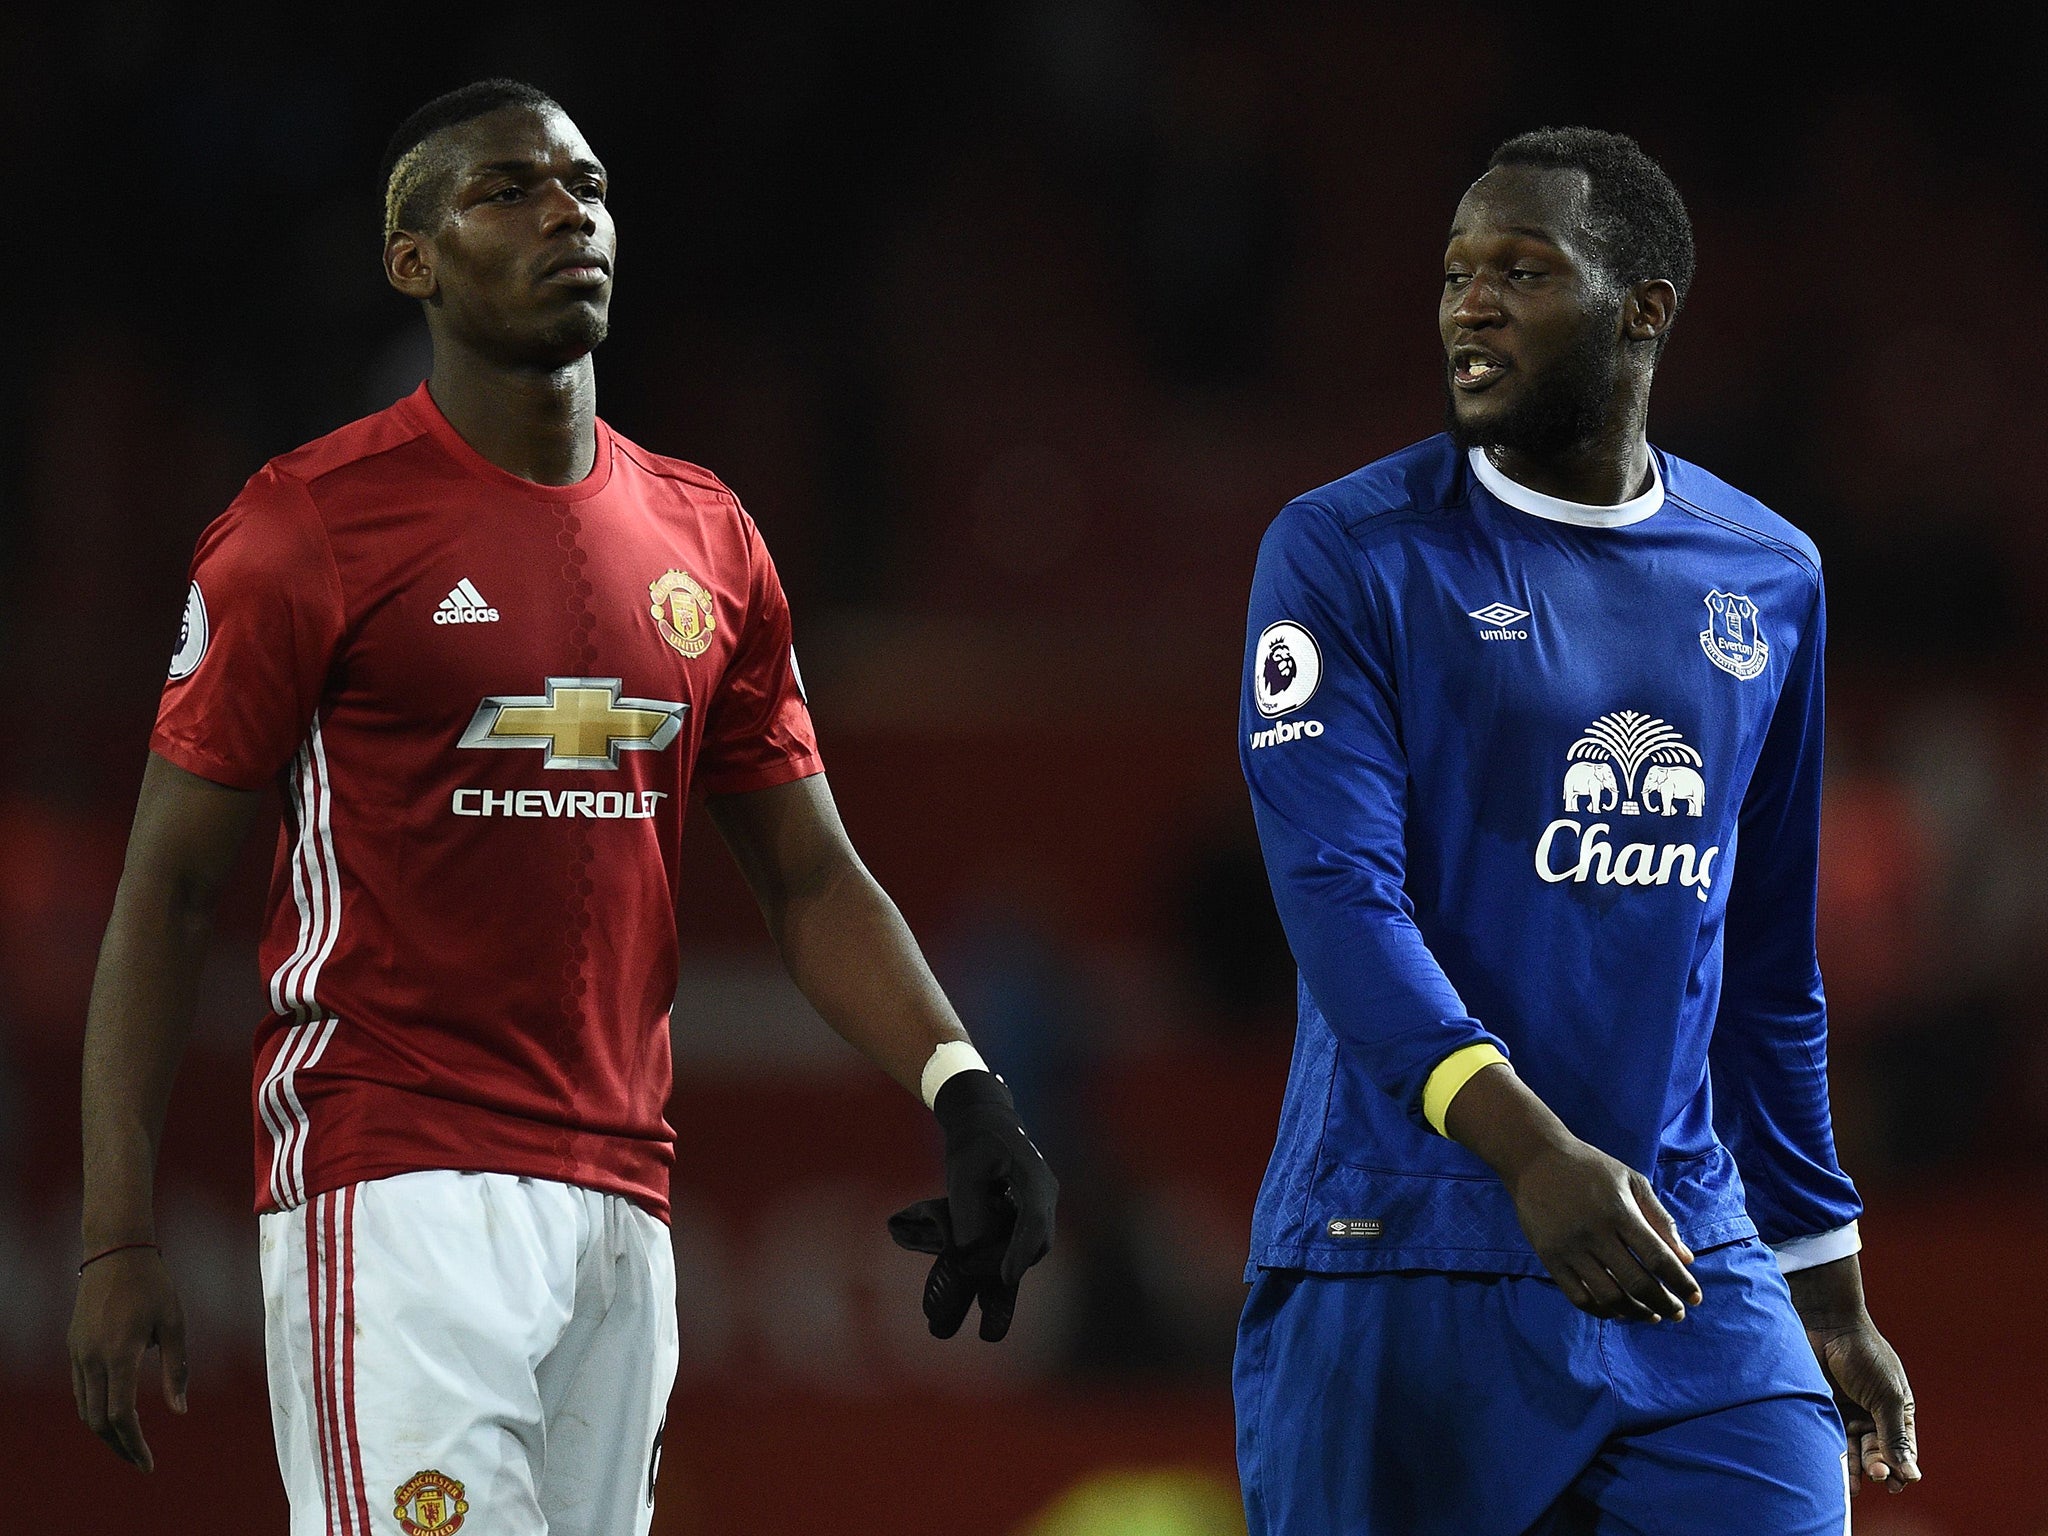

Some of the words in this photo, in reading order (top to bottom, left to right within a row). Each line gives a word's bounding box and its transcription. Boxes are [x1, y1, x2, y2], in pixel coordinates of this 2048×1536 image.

[433, 606, 500, 625] adidas
[670, 633, 705, 652] UNITED
[1480, 627, 1528, 640] umbro
[1718, 637, 1753, 656] Everton
[452, 789, 668, 819] CHEVROLET
[400, 1475, 459, 1501] MANCHESTER
